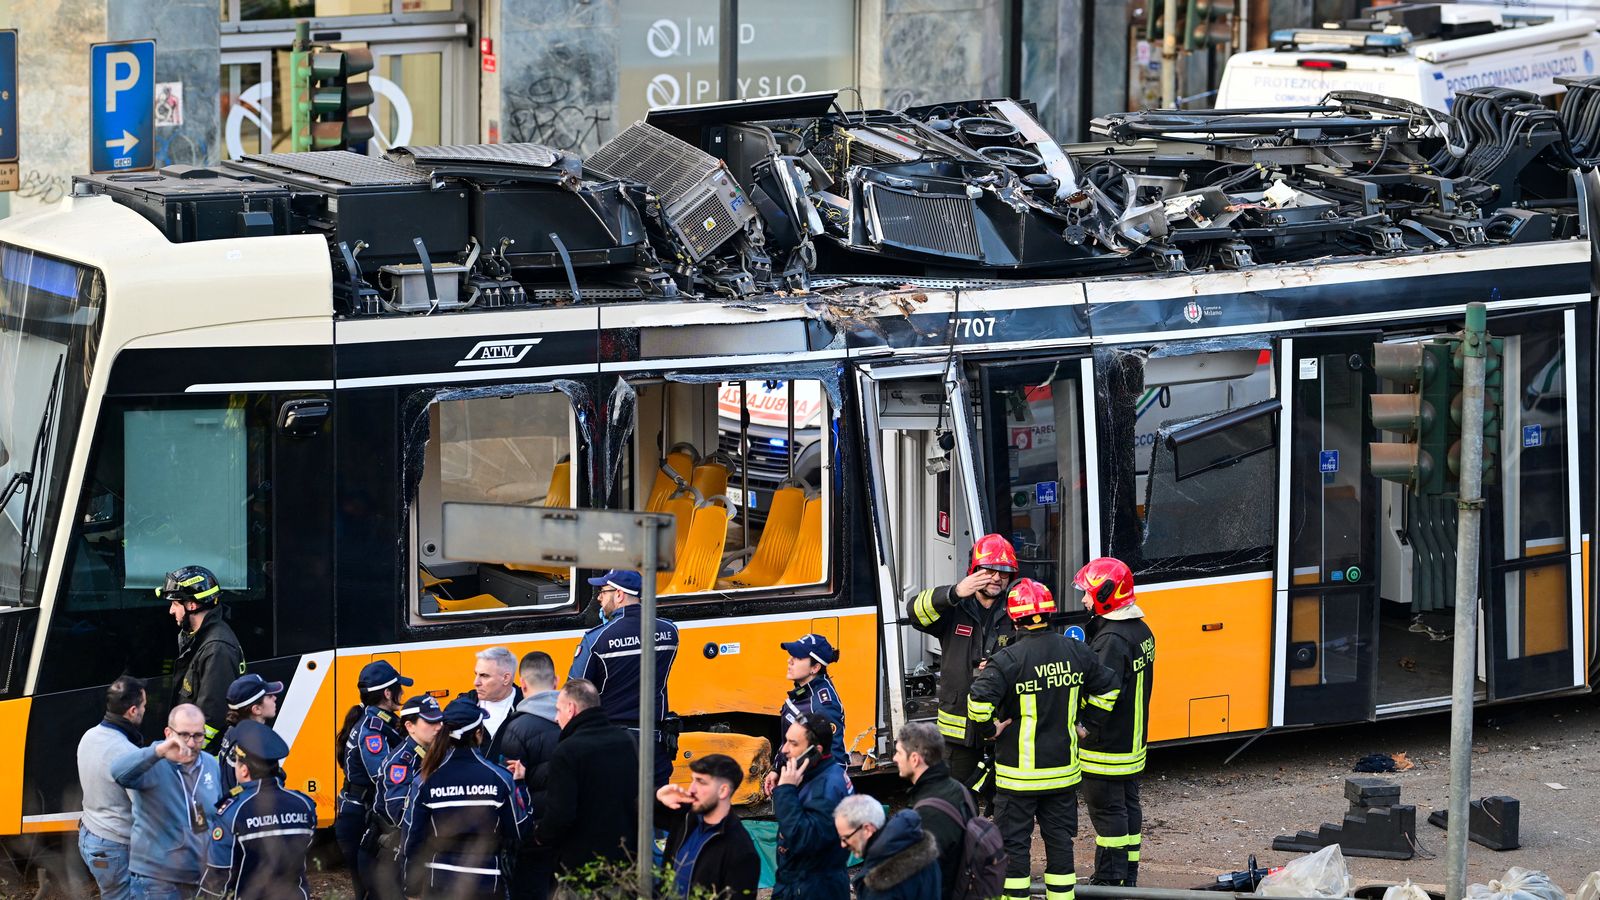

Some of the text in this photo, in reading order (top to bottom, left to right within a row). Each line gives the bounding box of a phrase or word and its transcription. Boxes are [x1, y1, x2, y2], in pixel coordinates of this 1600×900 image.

[697, 24, 755, 46] MD
[1481, 65, 1530, 88] COMANDO
[1531, 55, 1577, 80] AVANZATO
[105, 51, 140, 113] P
[696, 74, 807, 101] PYSIO
[1253, 76, 1339, 90] PROTEZIONE
[949, 317, 996, 338] 7707
[480, 345, 515, 359] ATM
[608, 631, 672, 649] POLIZIA CALE
[1034, 660, 1071, 678] VIGILI
[1015, 680, 1043, 695] DEL
[308, 780, 317, 792] B
[430, 785, 465, 798] POLIZIA
[246, 812, 308, 829] POLIZIA LOCALE
